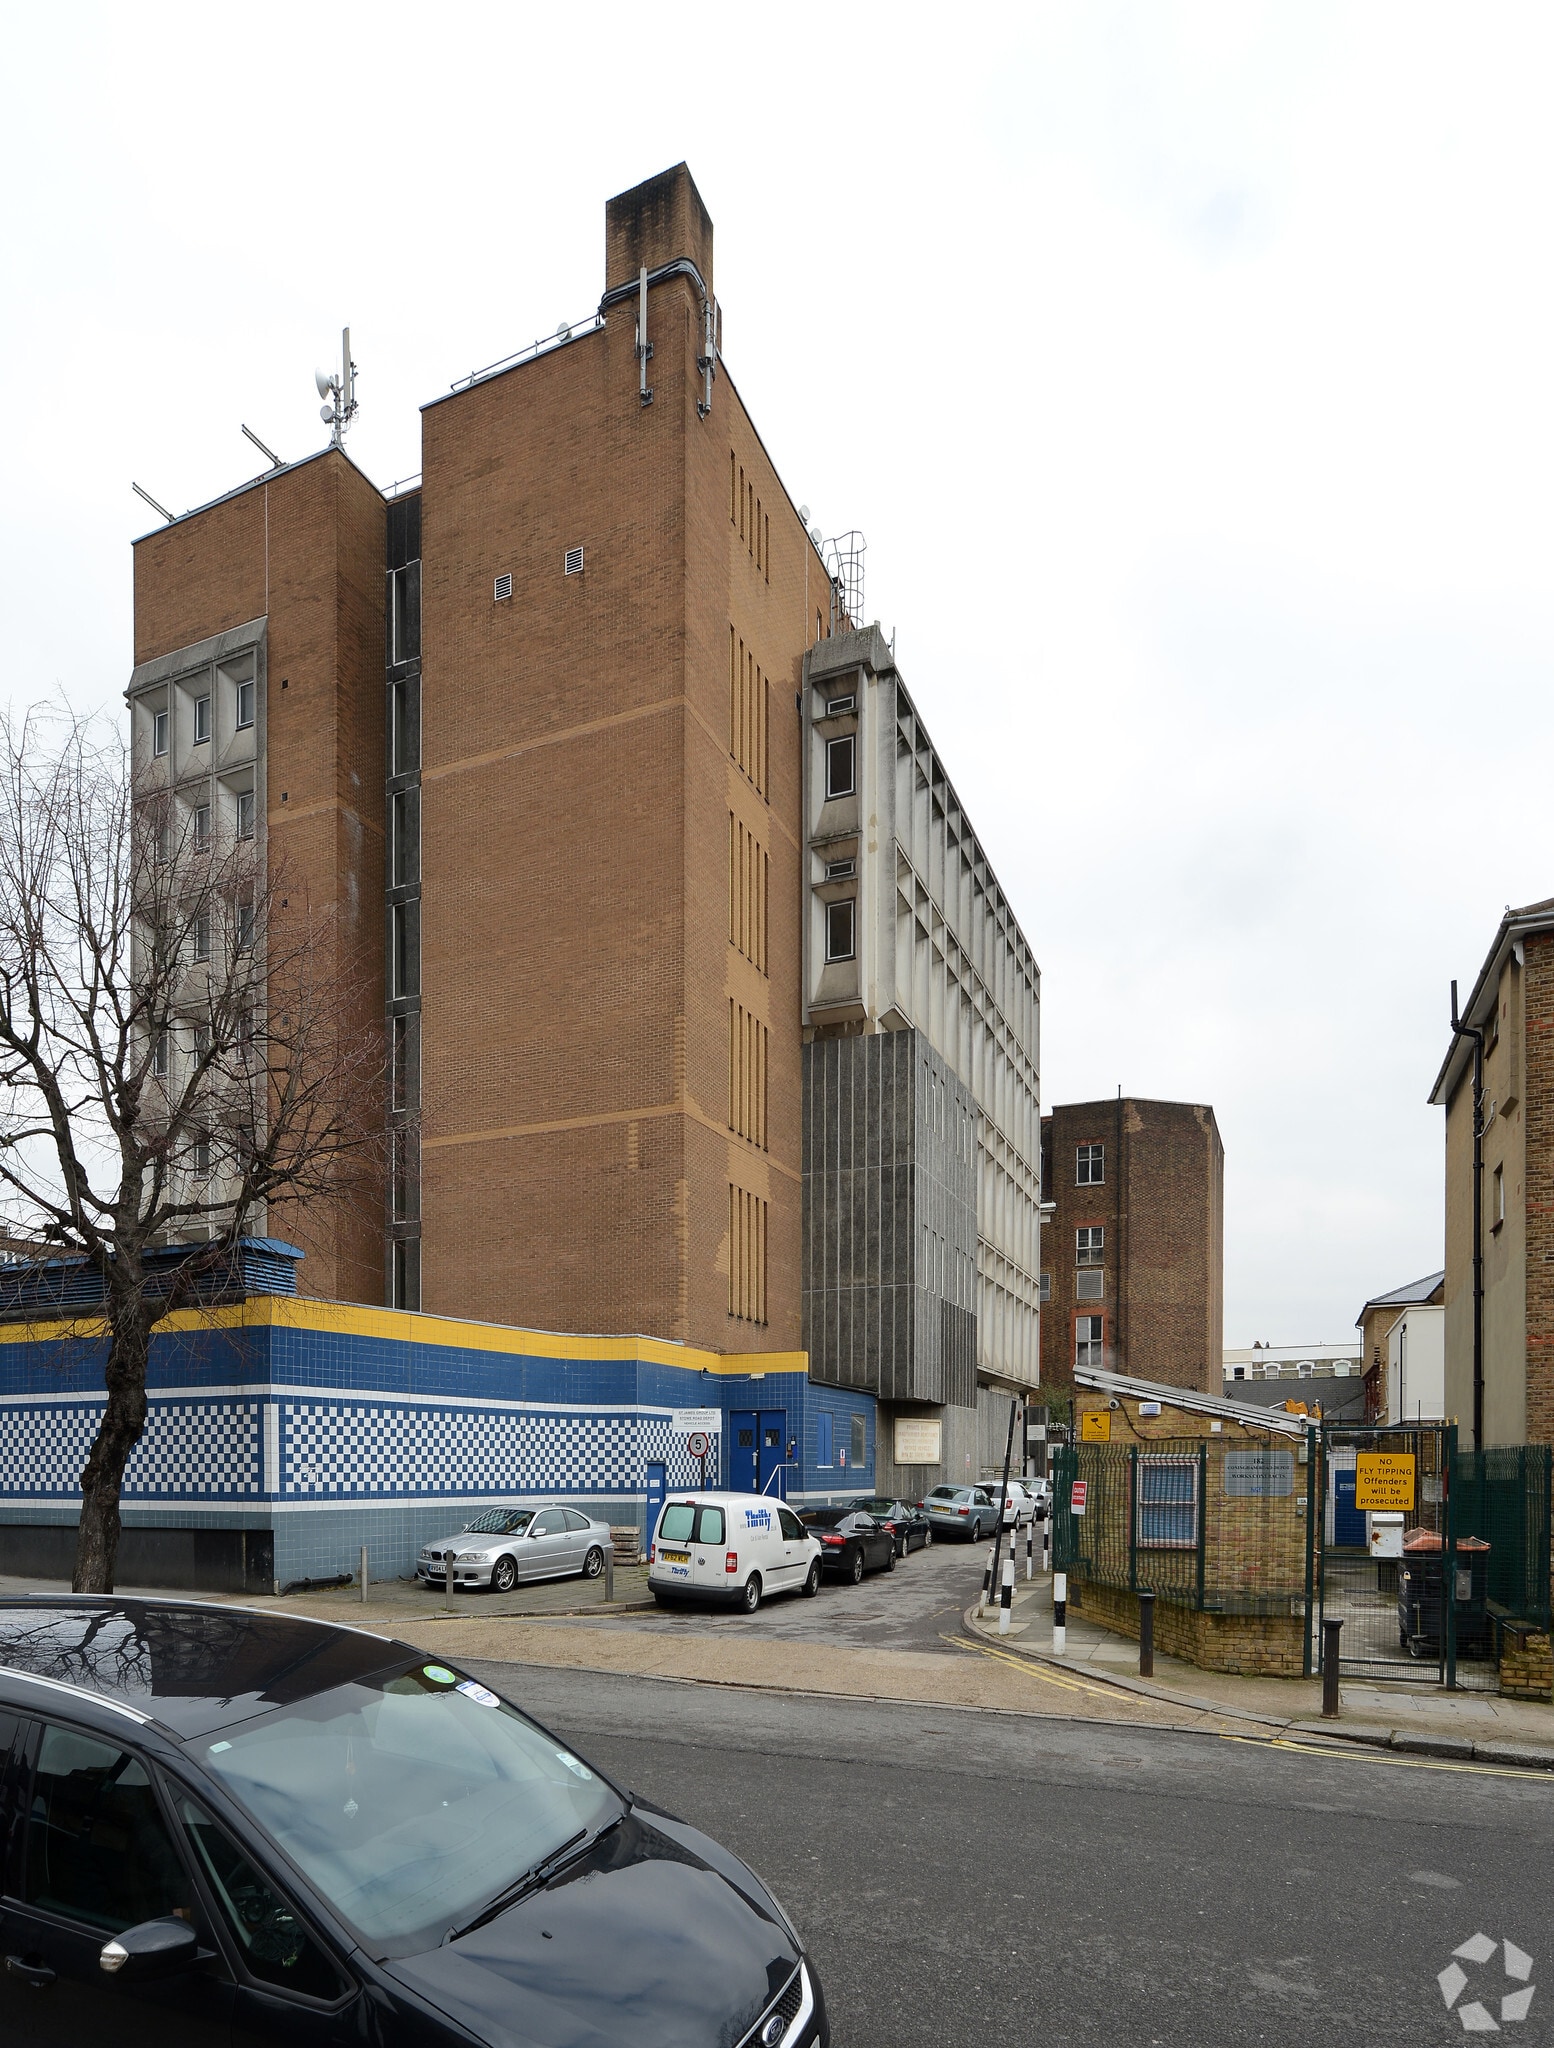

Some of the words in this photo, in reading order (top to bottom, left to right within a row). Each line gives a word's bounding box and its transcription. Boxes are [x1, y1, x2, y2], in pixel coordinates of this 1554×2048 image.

[695, 1439, 702, 1450] 5
[1364, 1477, 1407, 1485] Offenders
[745, 1509, 771, 1531] Thrifty
[671, 1567, 690, 1577] Thrifty
